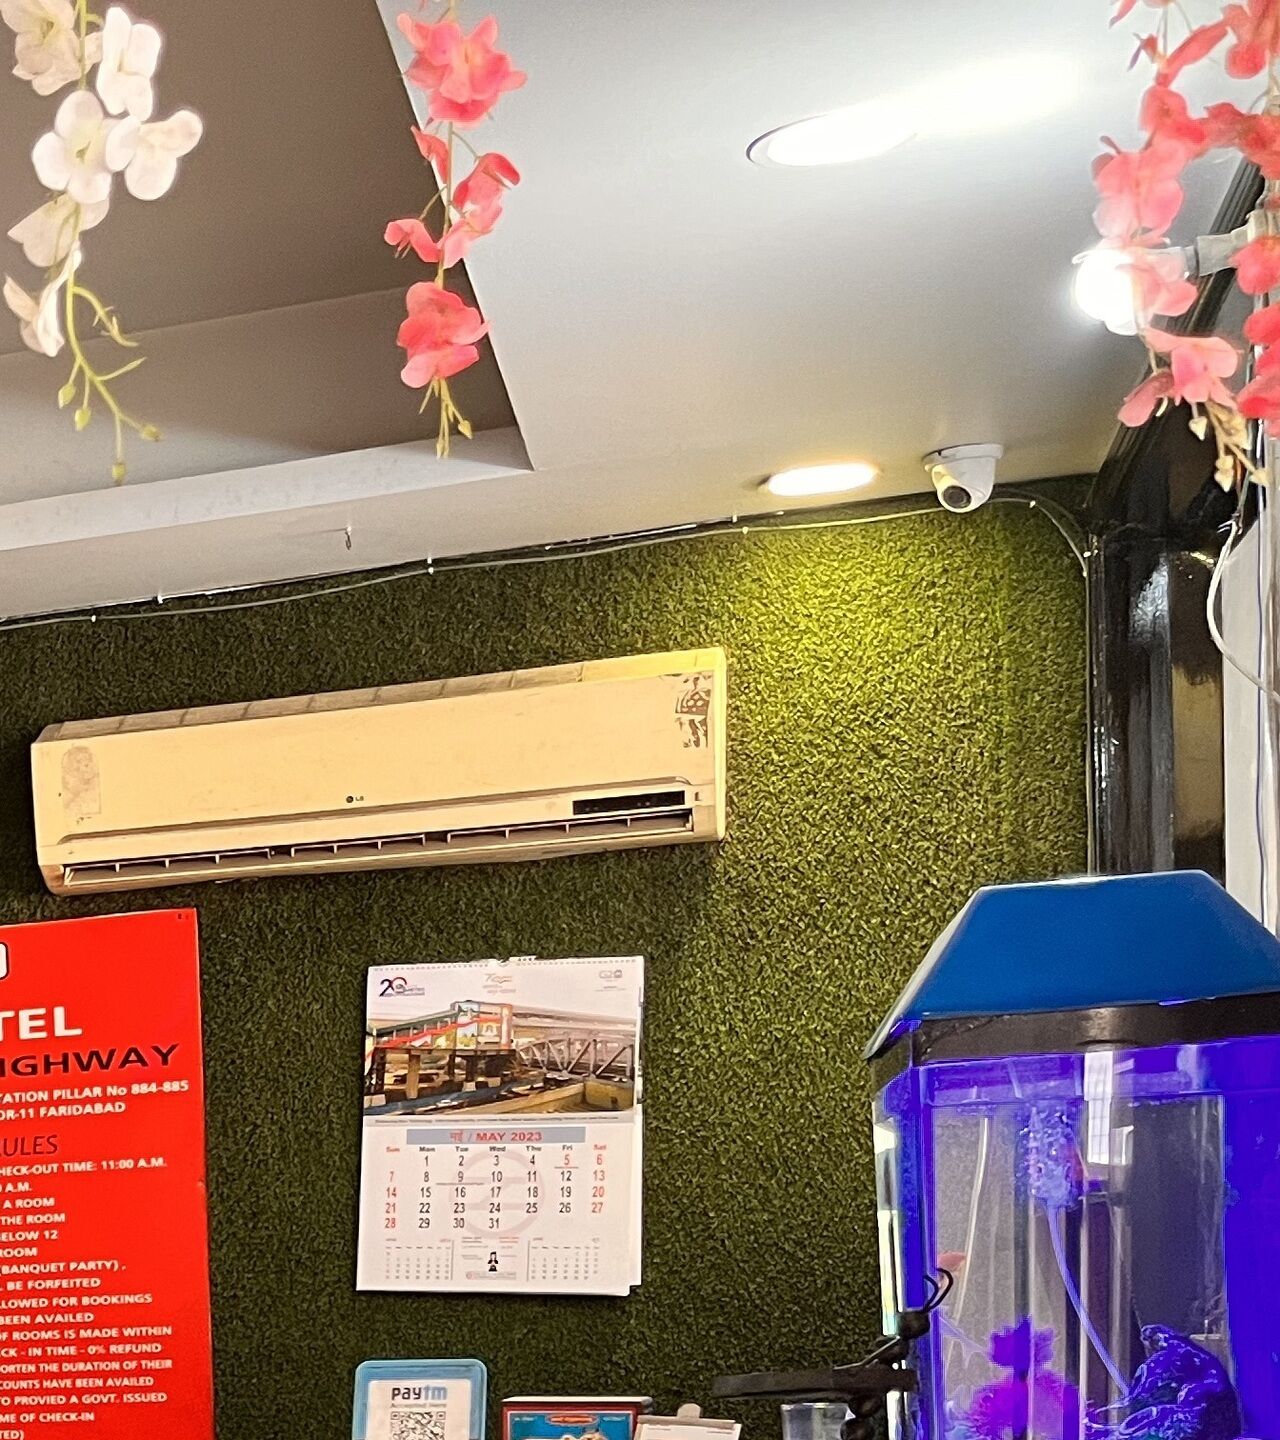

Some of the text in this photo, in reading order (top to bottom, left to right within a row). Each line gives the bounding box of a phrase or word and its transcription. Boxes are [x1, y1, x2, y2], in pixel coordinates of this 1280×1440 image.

[52, 1086, 102, 1100] PILLAR
[106, 1084, 127, 1096] No
[130, 1079, 189, 1094] 884-885
[39, 1100, 125, 1117] FARIDABAD
[476, 1132, 542, 1141] MAY 2023
[62, 1161, 96, 1172] TIME:
[101, 1158, 134, 1170] 11:00
[137, 1156, 166, 1168] A.M.
[424, 1154, 602, 1166] 1 2 3 4 5 6
[389, 1170, 604, 1182] 7 8 9 10 11 12 13
[4, 1181, 34, 1192] A.M.
[3, 1199, 12, 1208] A
[15, 1197, 55, 1208] ROOM
[0, 1215, 22, 1226] THE
[26, 1212, 65, 1224] ROOM
[44, 1229, 57, 1239] 12
[6, 1280, 22, 1290] BE
[27, 1277, 101, 1289] FORFEITED
[391, 1385, 447, 1400] paytm
